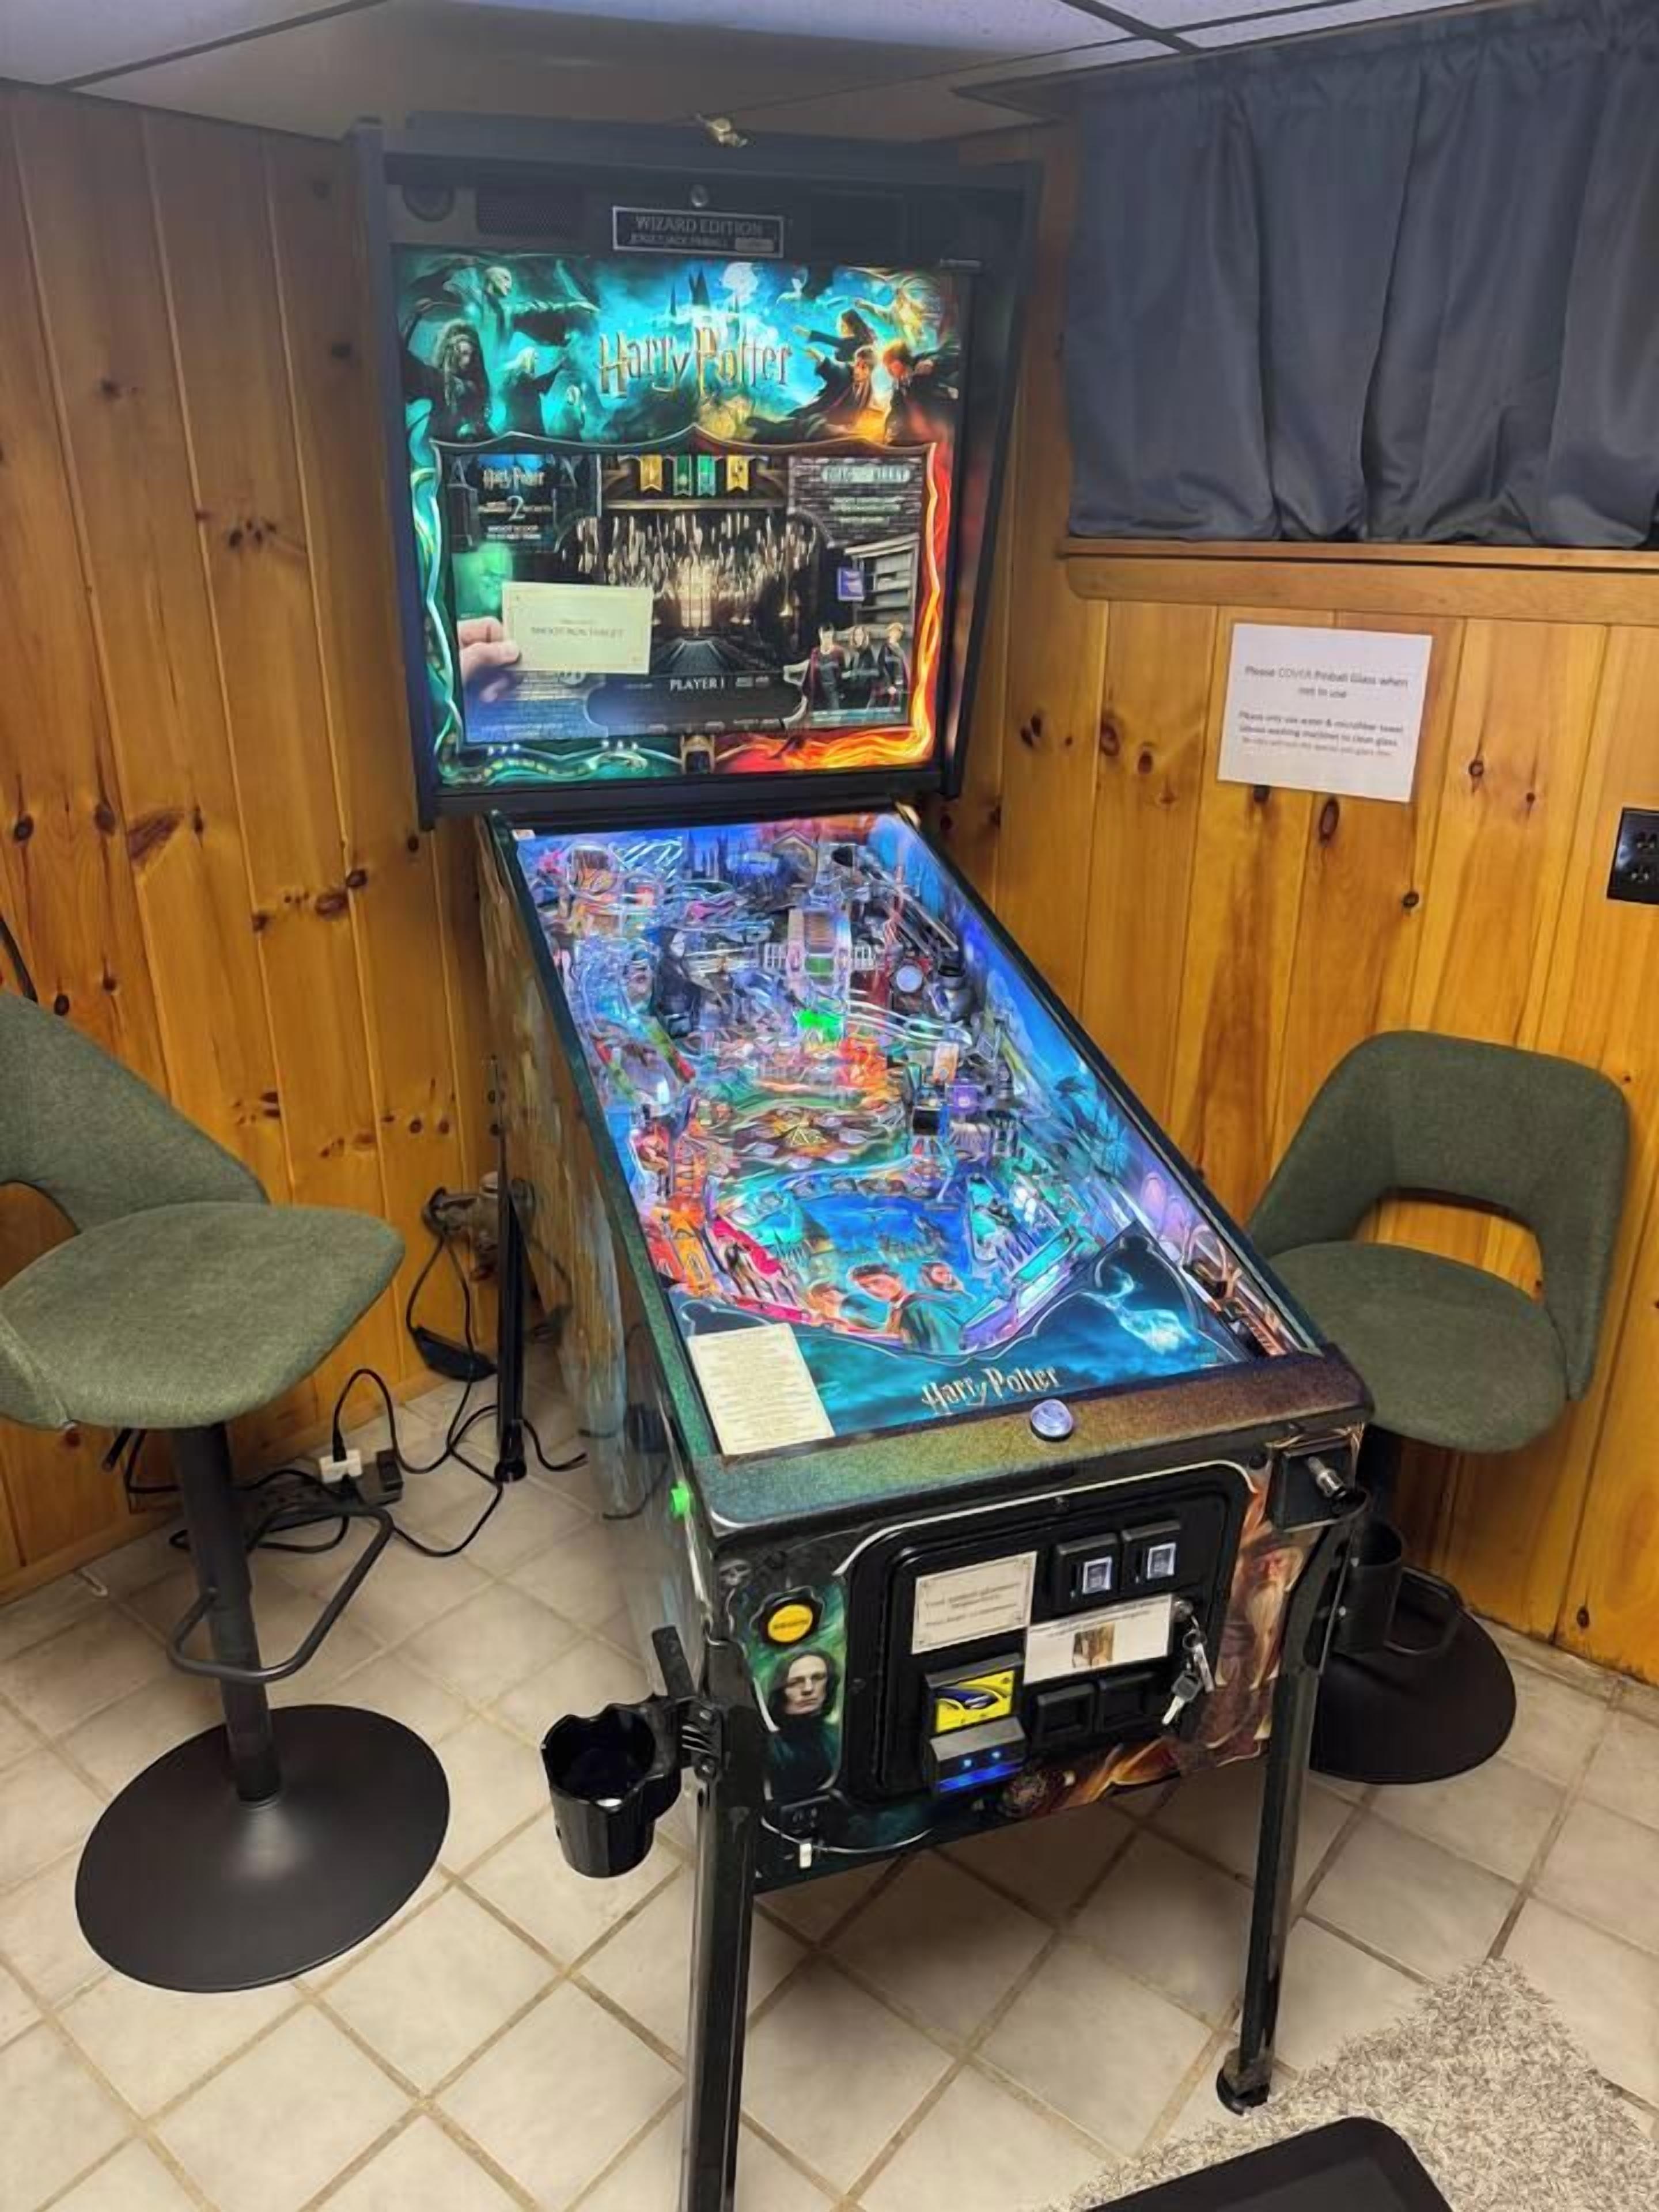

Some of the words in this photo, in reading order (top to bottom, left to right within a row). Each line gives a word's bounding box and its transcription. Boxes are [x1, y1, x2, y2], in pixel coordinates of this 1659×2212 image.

[636, 215, 697, 233] WIZARD
[699, 218, 763, 236] EDITION
[596, 330, 690, 398] Harry
[695, 327, 793, 400] Potter
[506, 495, 525, 521] 2
[1245, 665, 1275, 677] Please
[670, 677, 718, 691] PLAYER
[921, 1377, 987, 1416] Harry
[980, 1366, 1061, 1400] Potter
